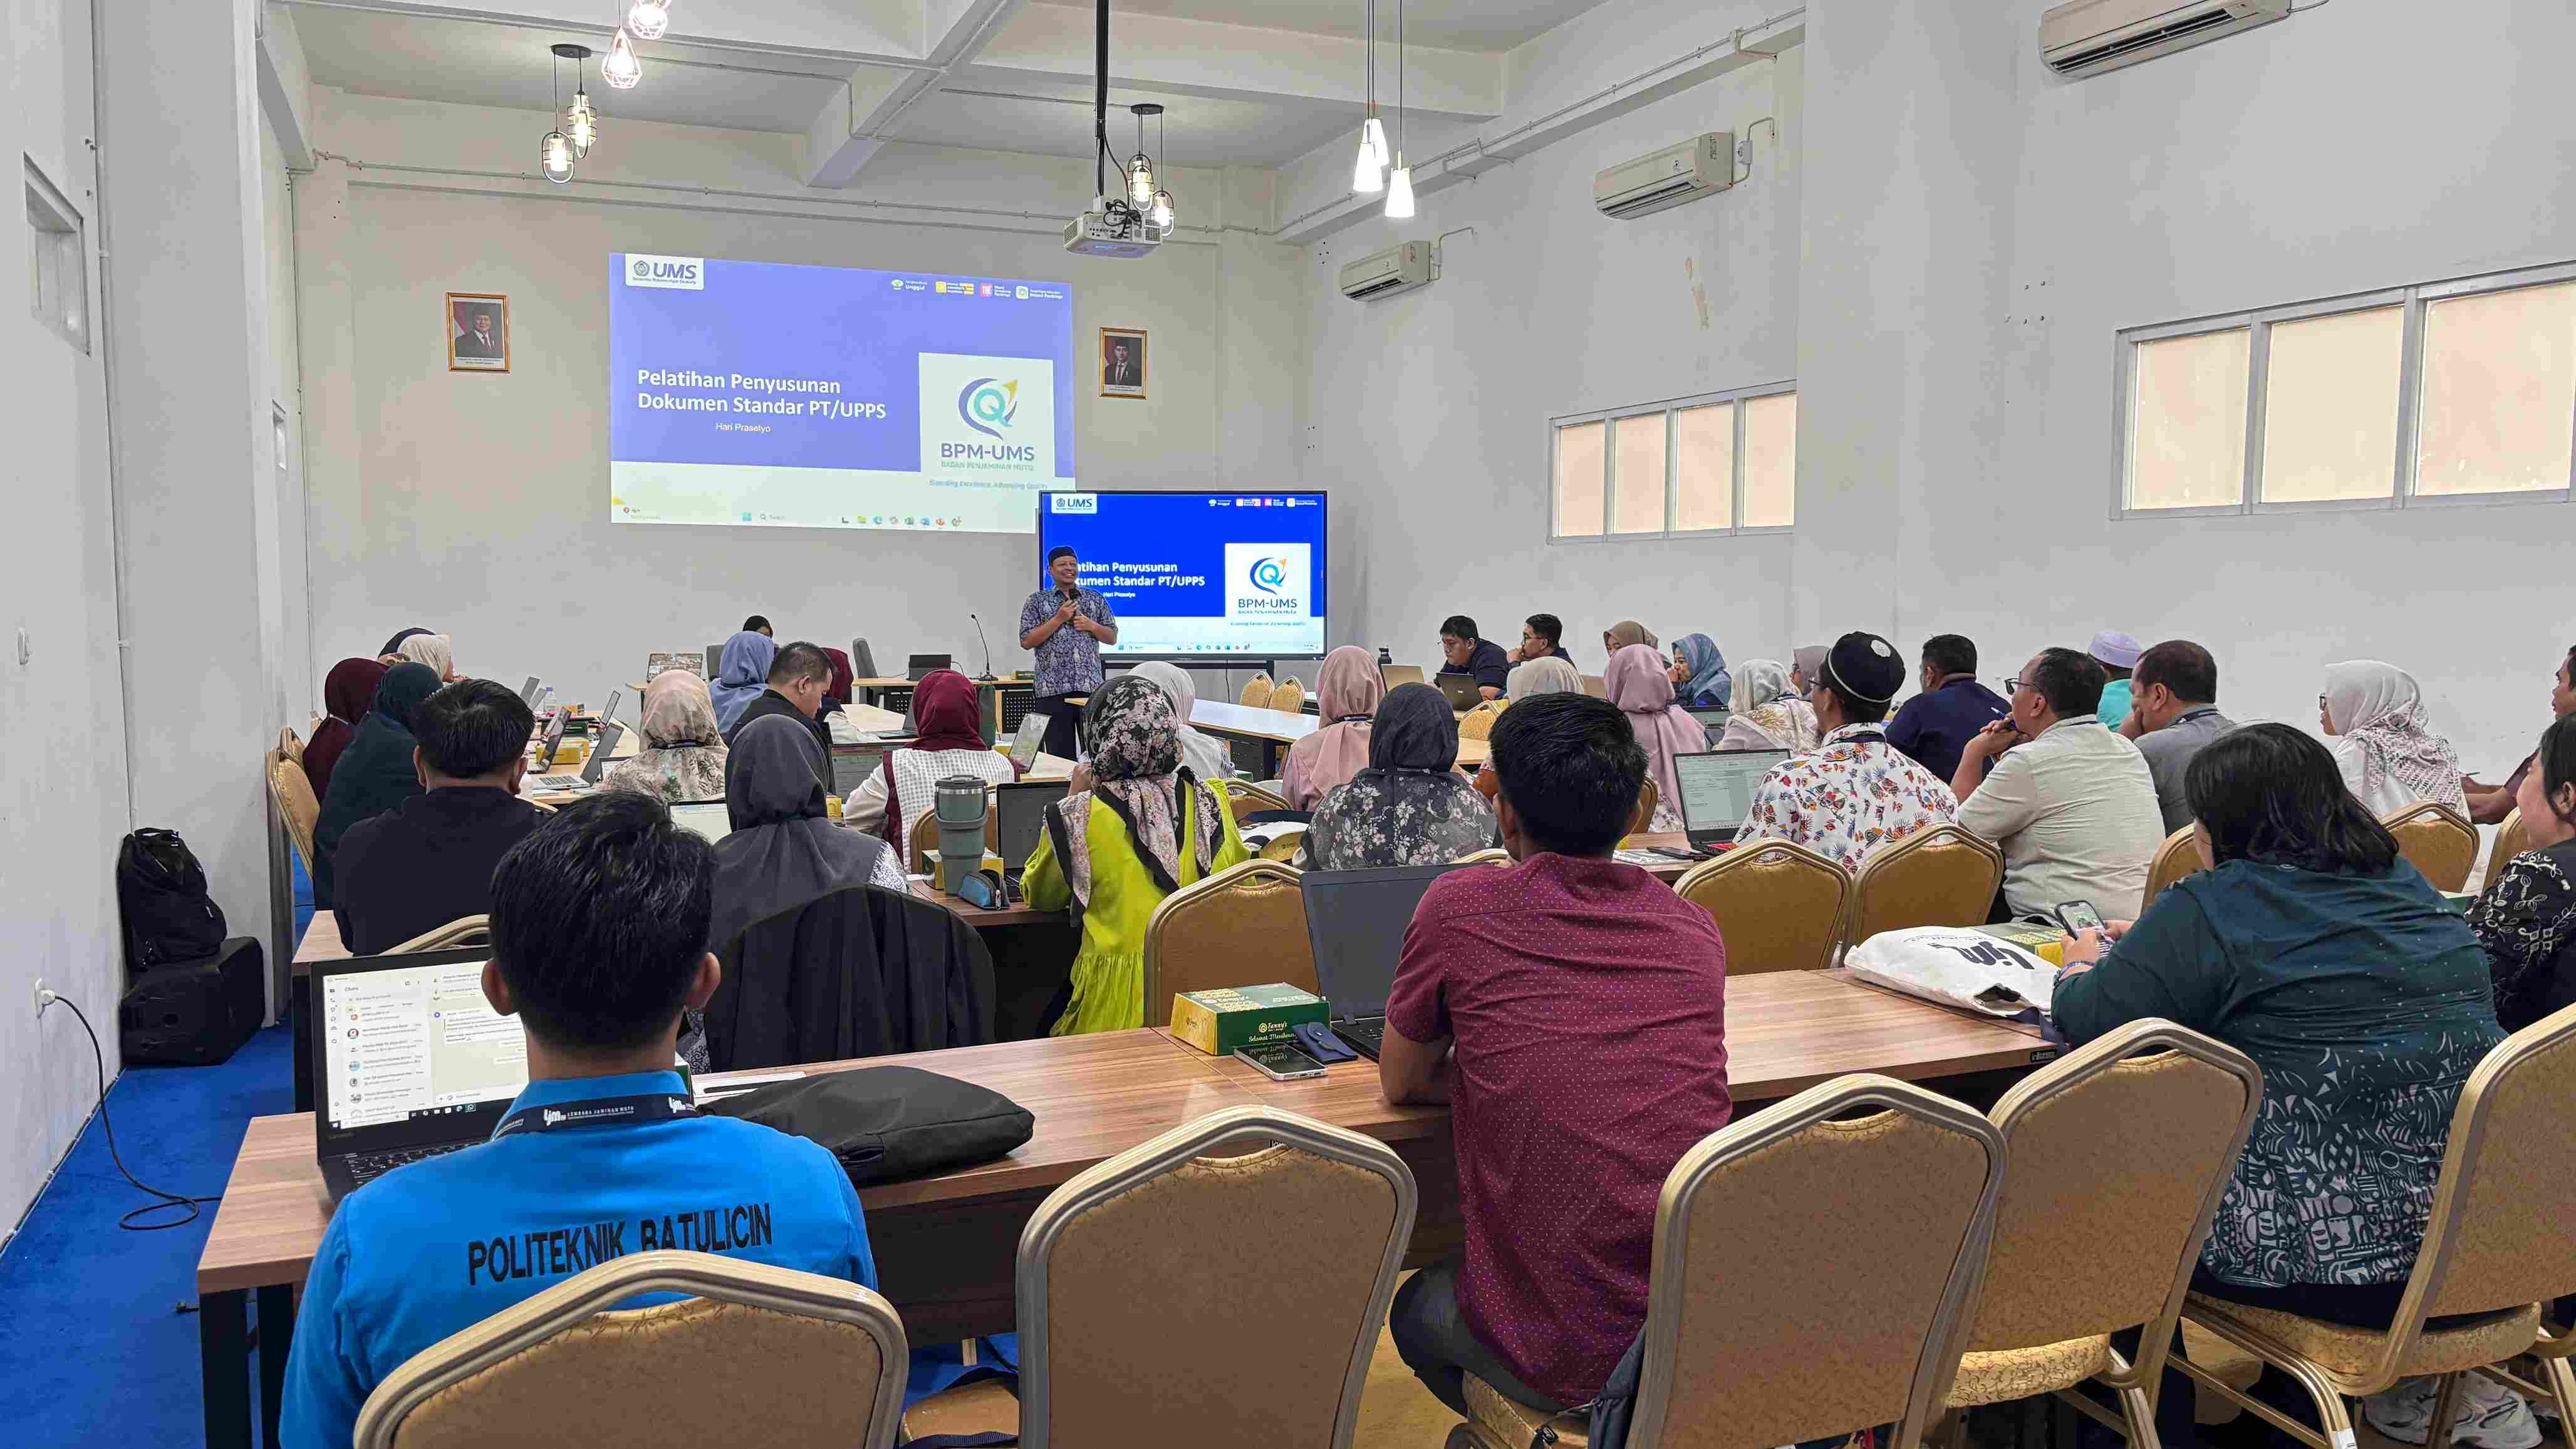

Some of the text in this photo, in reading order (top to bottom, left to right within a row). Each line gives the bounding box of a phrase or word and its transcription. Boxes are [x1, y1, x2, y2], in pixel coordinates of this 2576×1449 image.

[653, 262, 697, 279] UMS
[637, 369, 841, 395] Pelatihan Penyusunan
[638, 393, 886, 419] Dokumen Standar PT/UPPS
[716, 423, 771, 434] Hari Prasetyo
[941, 443, 1035, 462] BPM-UMS
[1067, 498, 1093, 507] UMS
[1112, 562, 1178, 574] Penyusunan
[1113, 576, 1155, 586] Standar
[1158, 575, 1205, 588] PT/UPPS
[1238, 598, 1297, 608] BPM-UMS
[468, 1202, 773, 1285] POLITEKNIK BATULICIN
